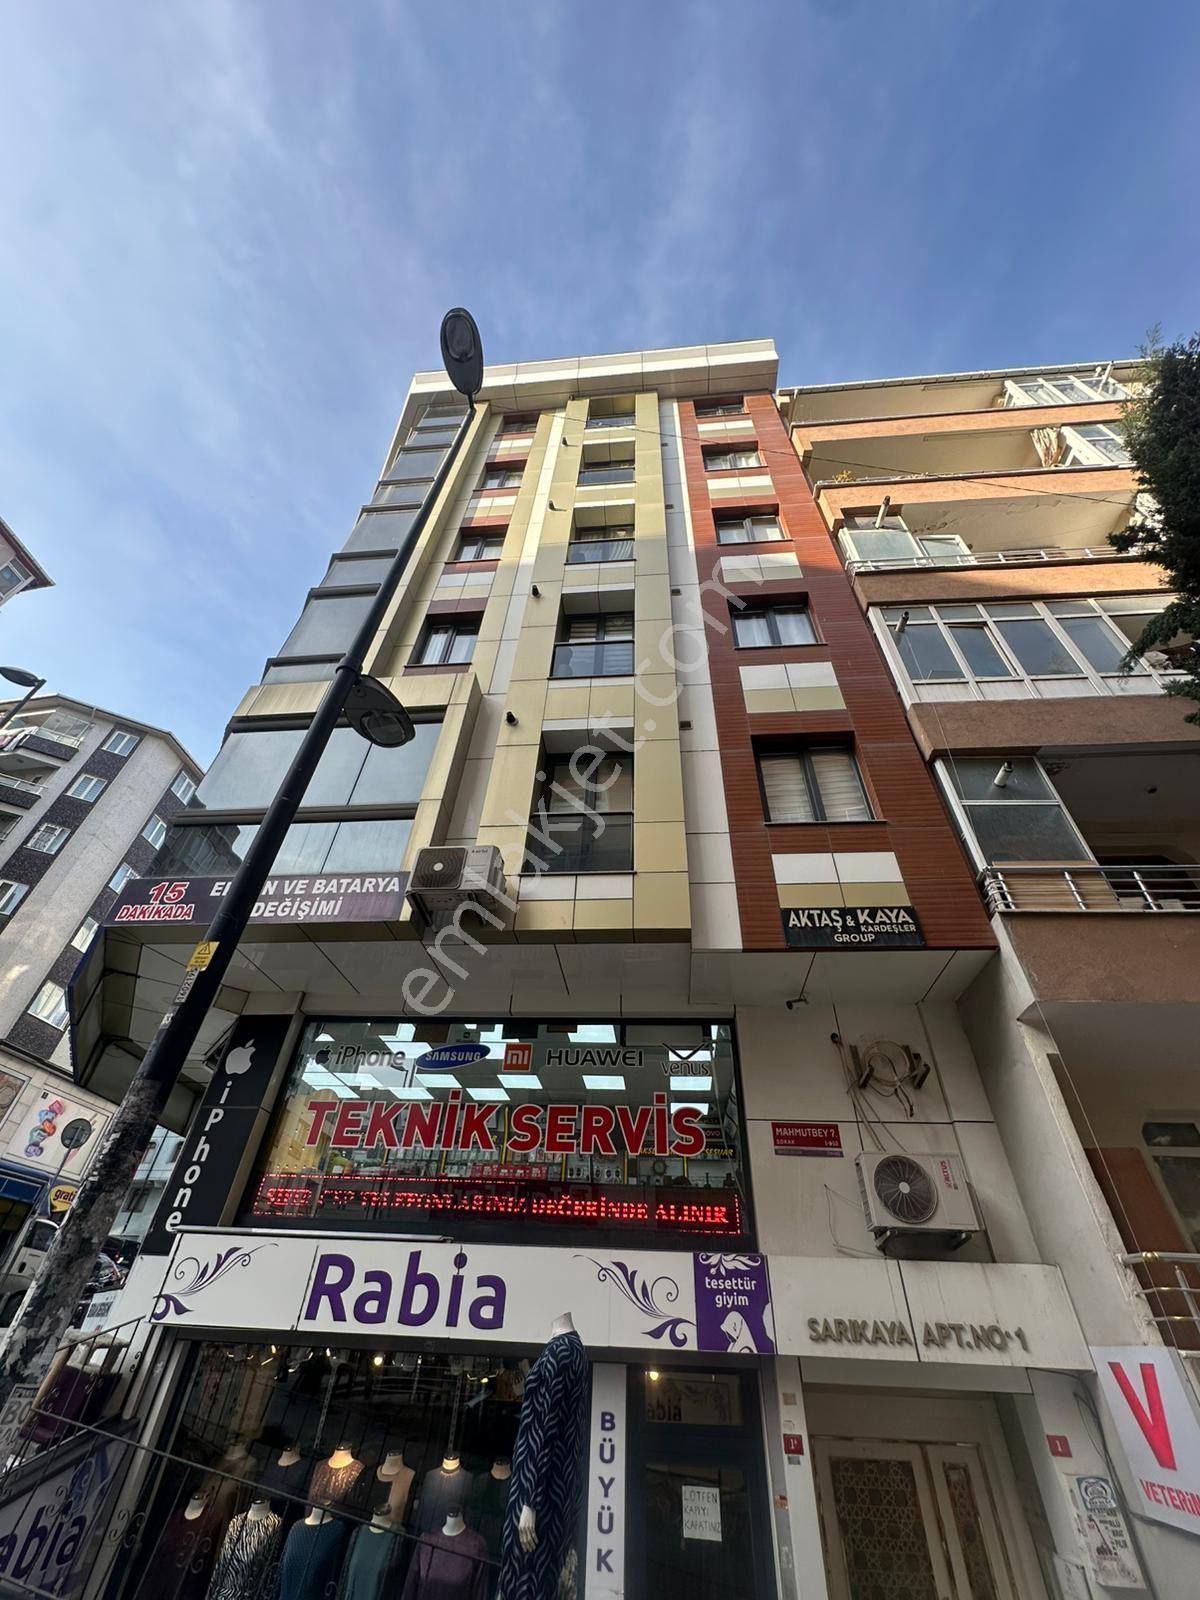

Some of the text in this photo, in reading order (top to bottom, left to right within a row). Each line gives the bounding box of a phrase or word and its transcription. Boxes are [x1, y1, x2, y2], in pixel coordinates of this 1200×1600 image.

[149, 881, 190, 904] 15
[283, 880, 309, 895] VE
[311, 877, 400, 894] BATARYA
[115, 902, 195, 921] DAKİKADA
[250, 896, 344, 920] DEĞİŞİMİ
[788, 908, 914, 932] AKTAŞ & KAYA
[860, 924, 917, 934] KARDEŞLER
[834, 933, 876, 943] GROUP
[335, 1046, 406, 1066] iPhone
[425, 1049, 482, 1061] SAMSUNG
[546, 1048, 644, 1067] HUAWEI
[660, 1061, 712, 1076] venus
[305, 1089, 707, 1157] TEKNİK SERVİS
[775, 1127, 828, 1138] MAHMUTBEY
[164, 1080, 233, 1232] iPhone
[52, 1188, 77, 1202] grati
[304, 1250, 507, 1330] Rabia
[704, 1276, 757, 1291] tesettür
[715, 1291, 749, 1308] giyim
[807, 1317, 914, 1346] SARIKAYA
[1107, 1361, 1178, 1472] V
[596, 1411, 616, 1574] BÜYÜK
